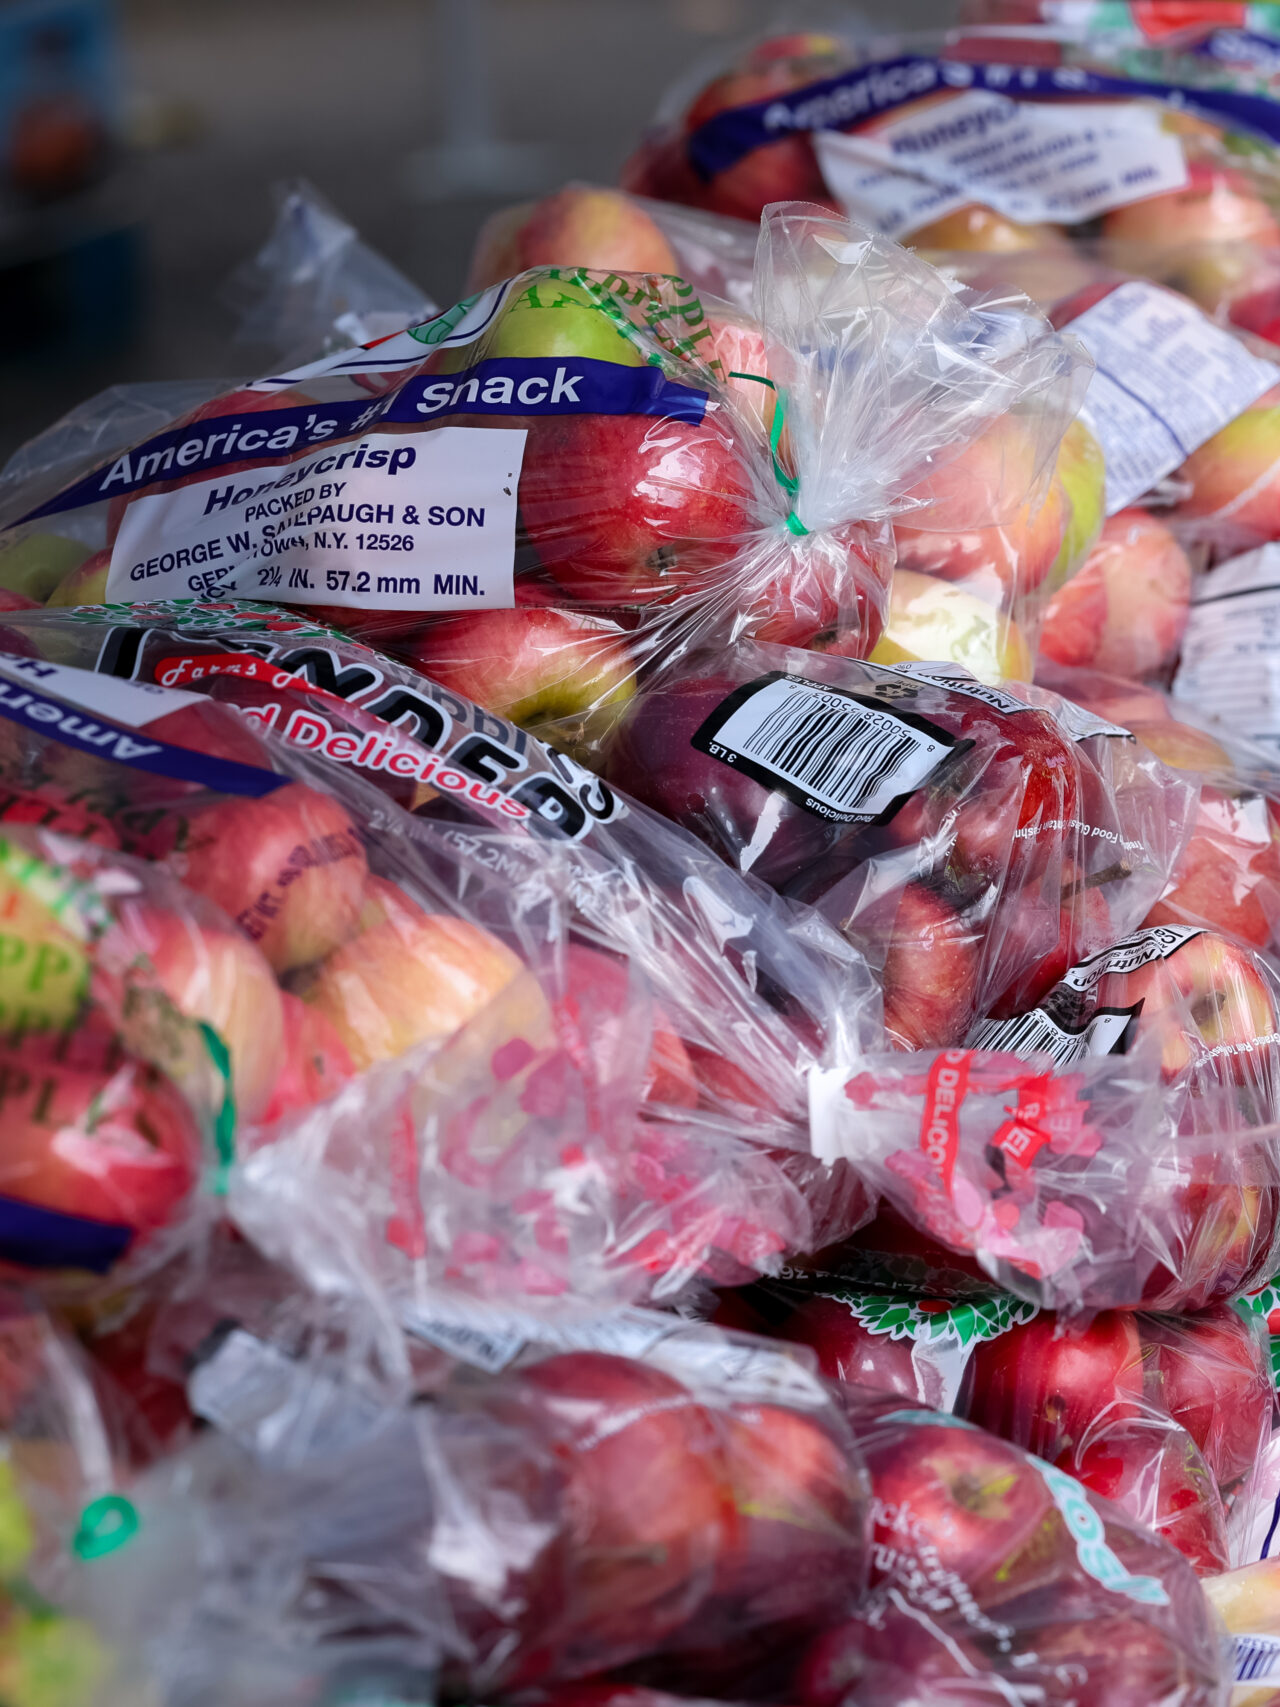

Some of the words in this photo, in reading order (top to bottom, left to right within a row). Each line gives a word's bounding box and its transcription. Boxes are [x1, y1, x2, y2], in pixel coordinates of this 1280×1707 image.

[99, 413, 338, 491] America's
[416, 366, 584, 415] snack
[203, 443, 417, 516] Honeycrisp
[245, 489, 315, 523] PACKED
[319, 481, 348, 500] BY
[130, 538, 225, 582] GEORGE
[226, 531, 258, 554] W.
[402, 507, 421, 526] &
[427, 506, 487, 527] SON
[314, 532, 348, 550] N.Y.
[355, 533, 415, 552] 12526
[288, 568, 315, 589] IN.
[326, 571, 371, 592] 57.2
[377, 577, 421, 595] mm
[433, 574, 486, 597] MIN.
[784, 674, 833, 692] APPLES
[863, 711, 912, 738] 50028
[708, 742, 727, 758] LB.
[284, 709, 531, 821] Delicious
[805, 798, 861, 823] Delicious
[1092, 830, 1119, 844] Food
